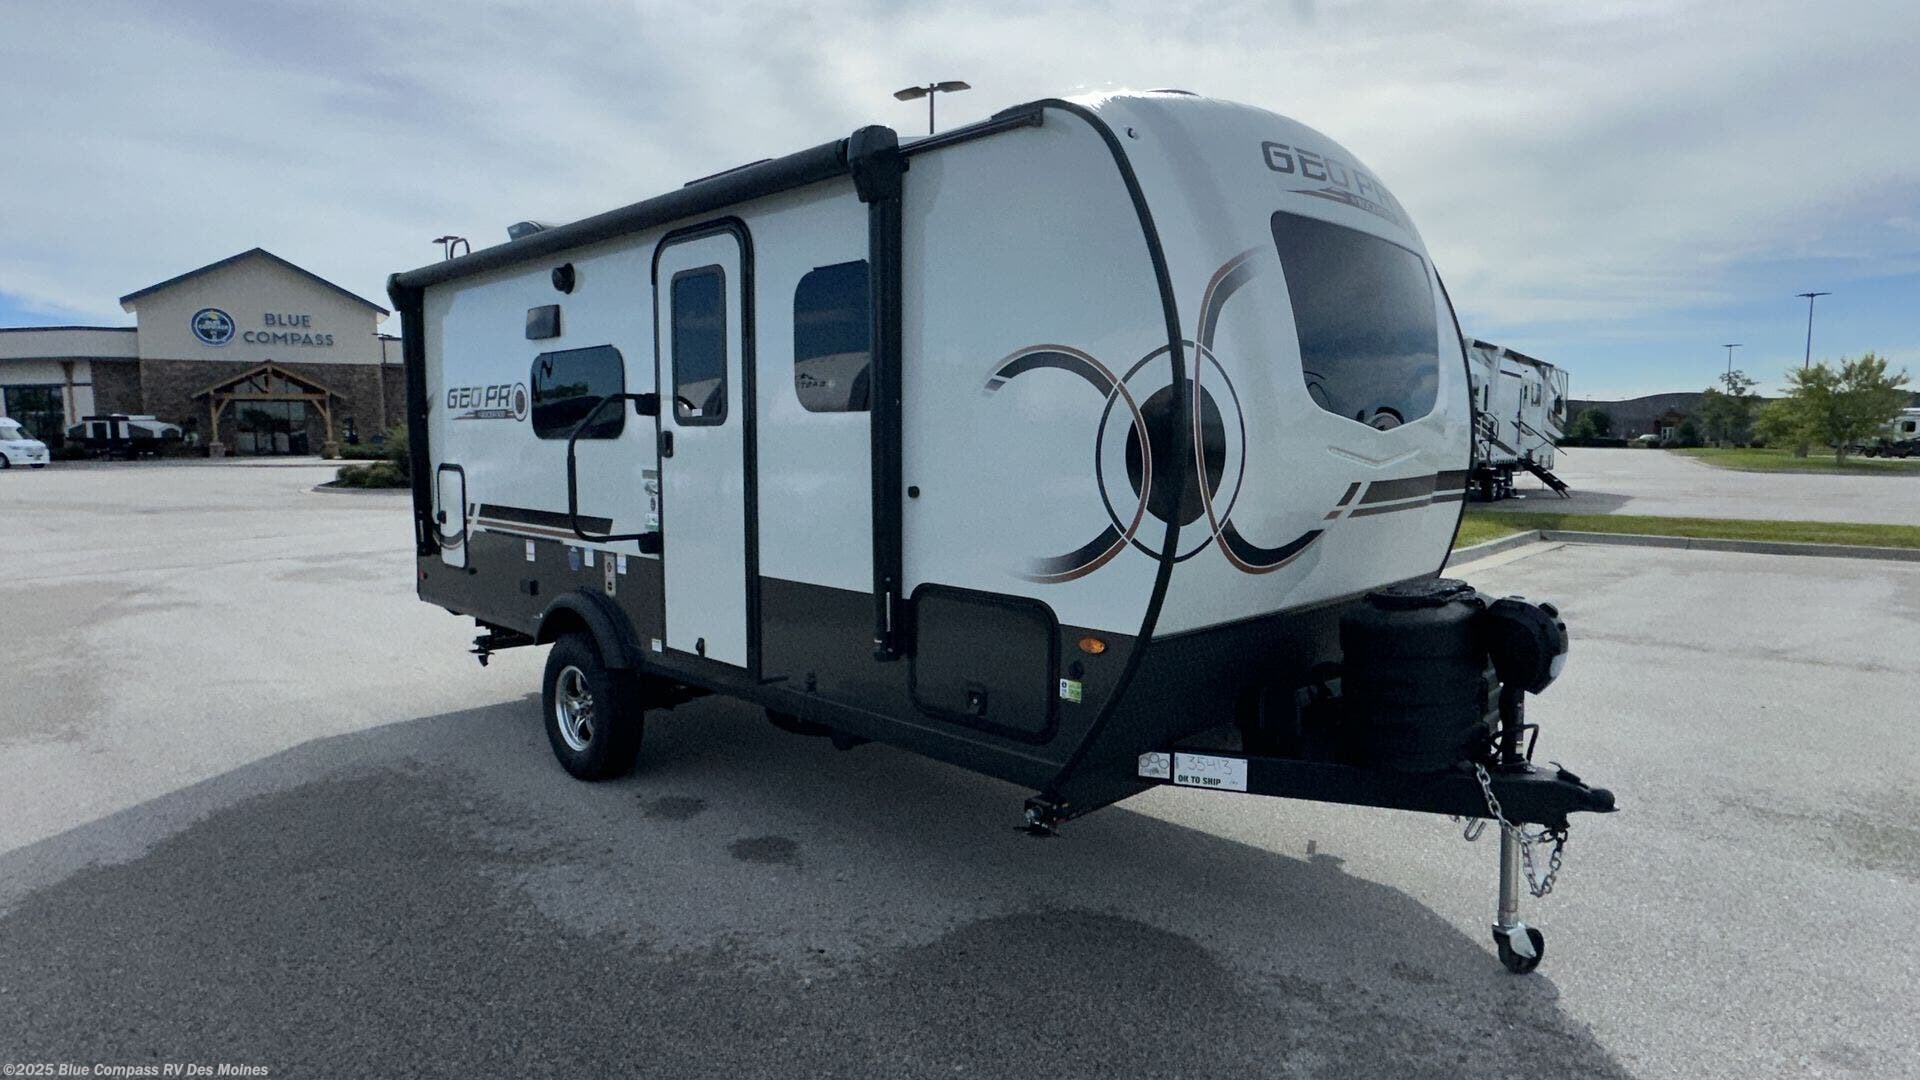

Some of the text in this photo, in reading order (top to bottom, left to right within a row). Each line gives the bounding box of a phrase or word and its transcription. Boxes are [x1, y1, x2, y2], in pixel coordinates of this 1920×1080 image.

[1261, 140, 1349, 187] GEO
[264, 312, 312, 328] BLUE
[242, 330, 335, 347] COMPASS
[446, 387, 482, 409] GEO
[1177, 774, 1189, 783] OK
[1191, 775, 1201, 784] TO
[1202, 777, 1222, 786] SHIP
